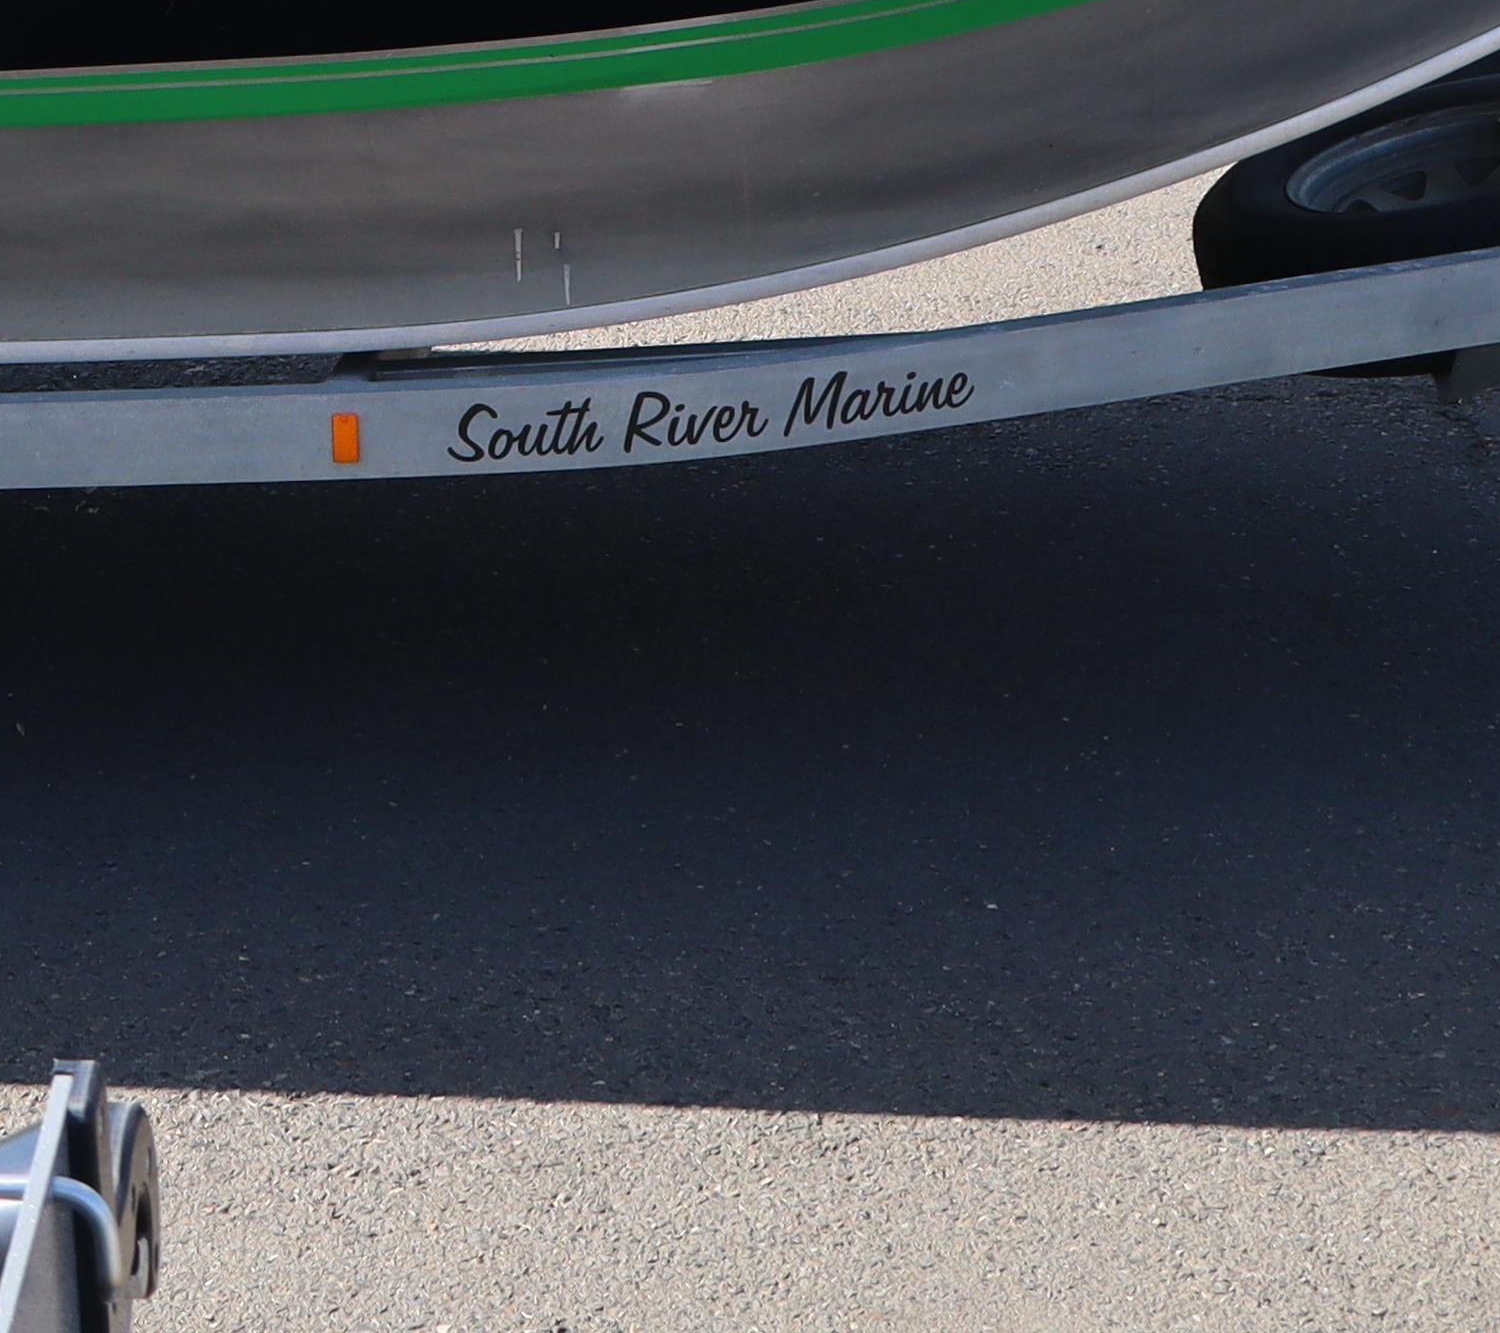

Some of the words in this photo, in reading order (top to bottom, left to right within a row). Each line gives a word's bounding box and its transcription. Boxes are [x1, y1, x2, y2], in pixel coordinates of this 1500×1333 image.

[446, 397, 605, 464] South
[622, 389, 769, 447] River
[783, 369, 976, 437] Marine
